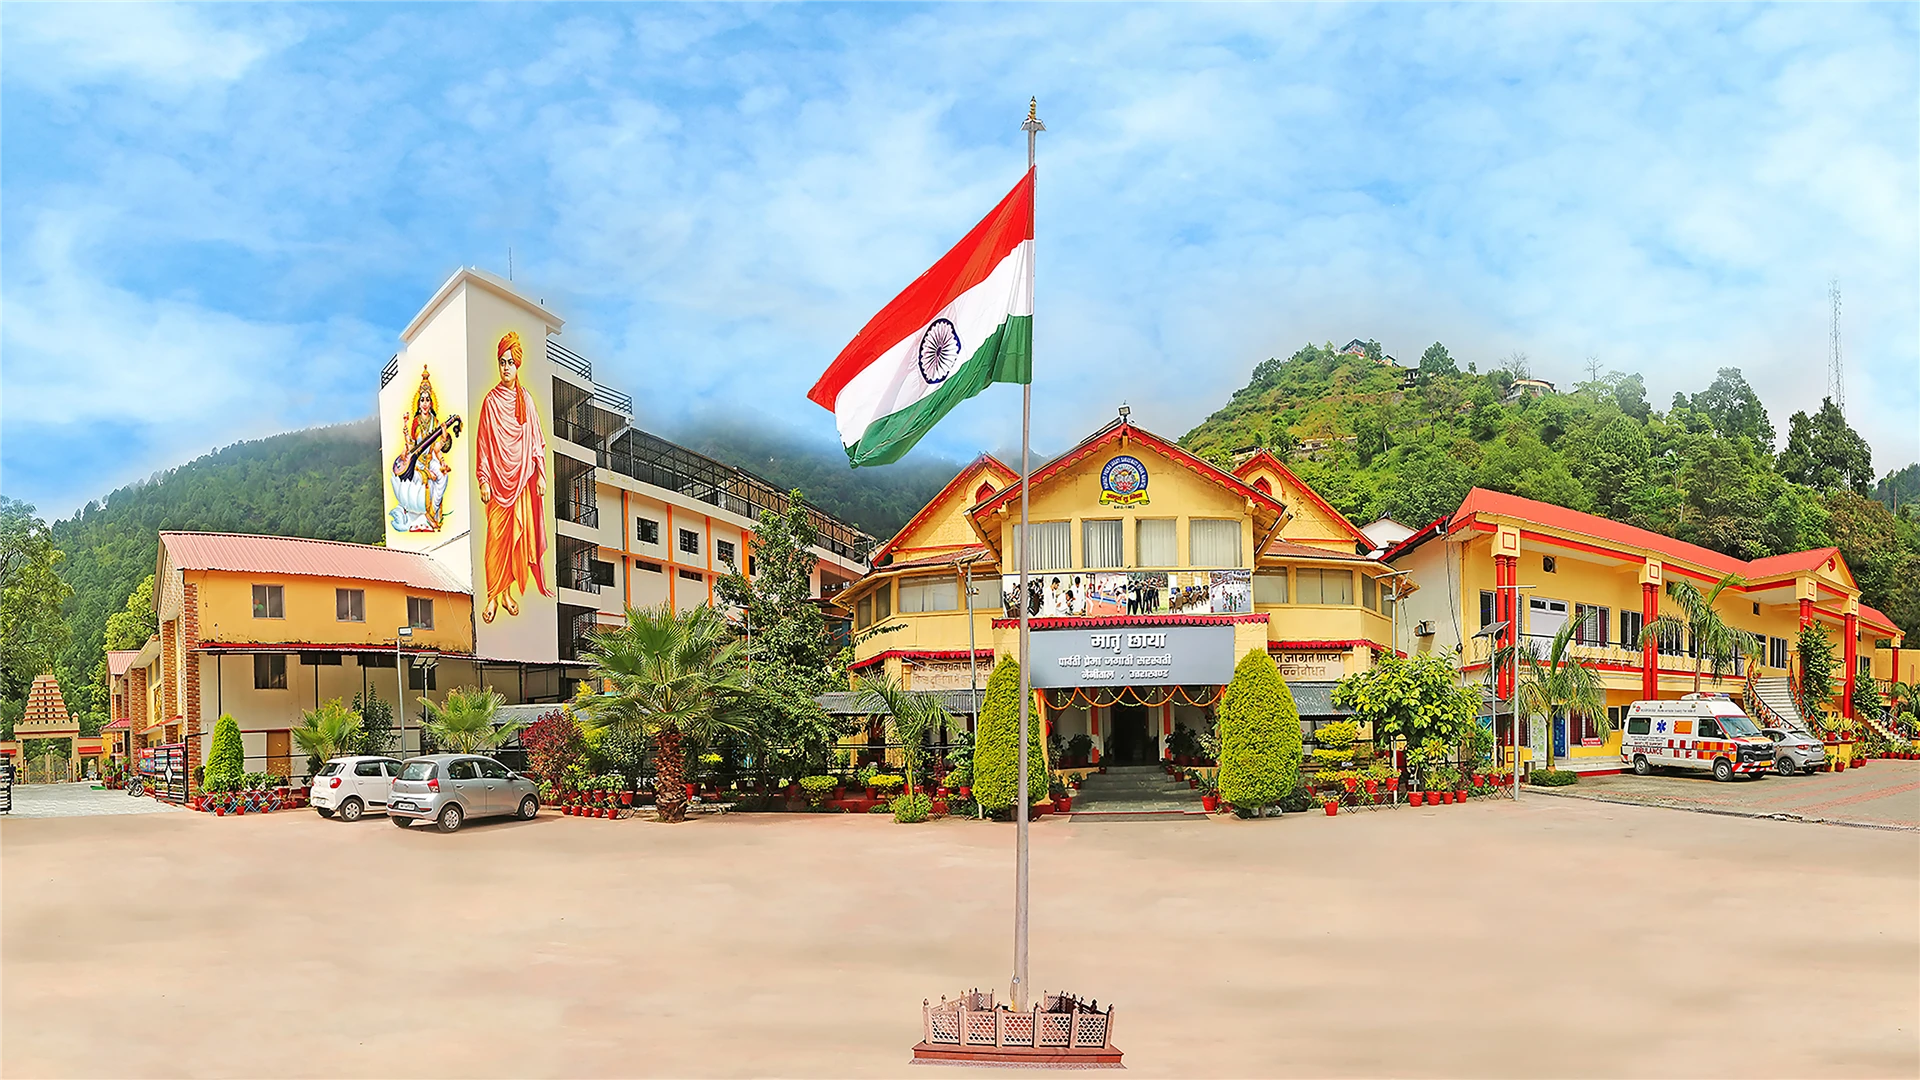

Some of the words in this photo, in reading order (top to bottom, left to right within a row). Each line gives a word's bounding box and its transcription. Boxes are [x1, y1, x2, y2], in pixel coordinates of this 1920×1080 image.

[1091, 633, 1121, 654] मातृ
[1127, 633, 1167, 648] छाया
[1058, 655, 1081, 667] पार्वती
[1136, 653, 1172, 667] सरस्वती
[1632, 746, 1663, 755] AMBULANCE
